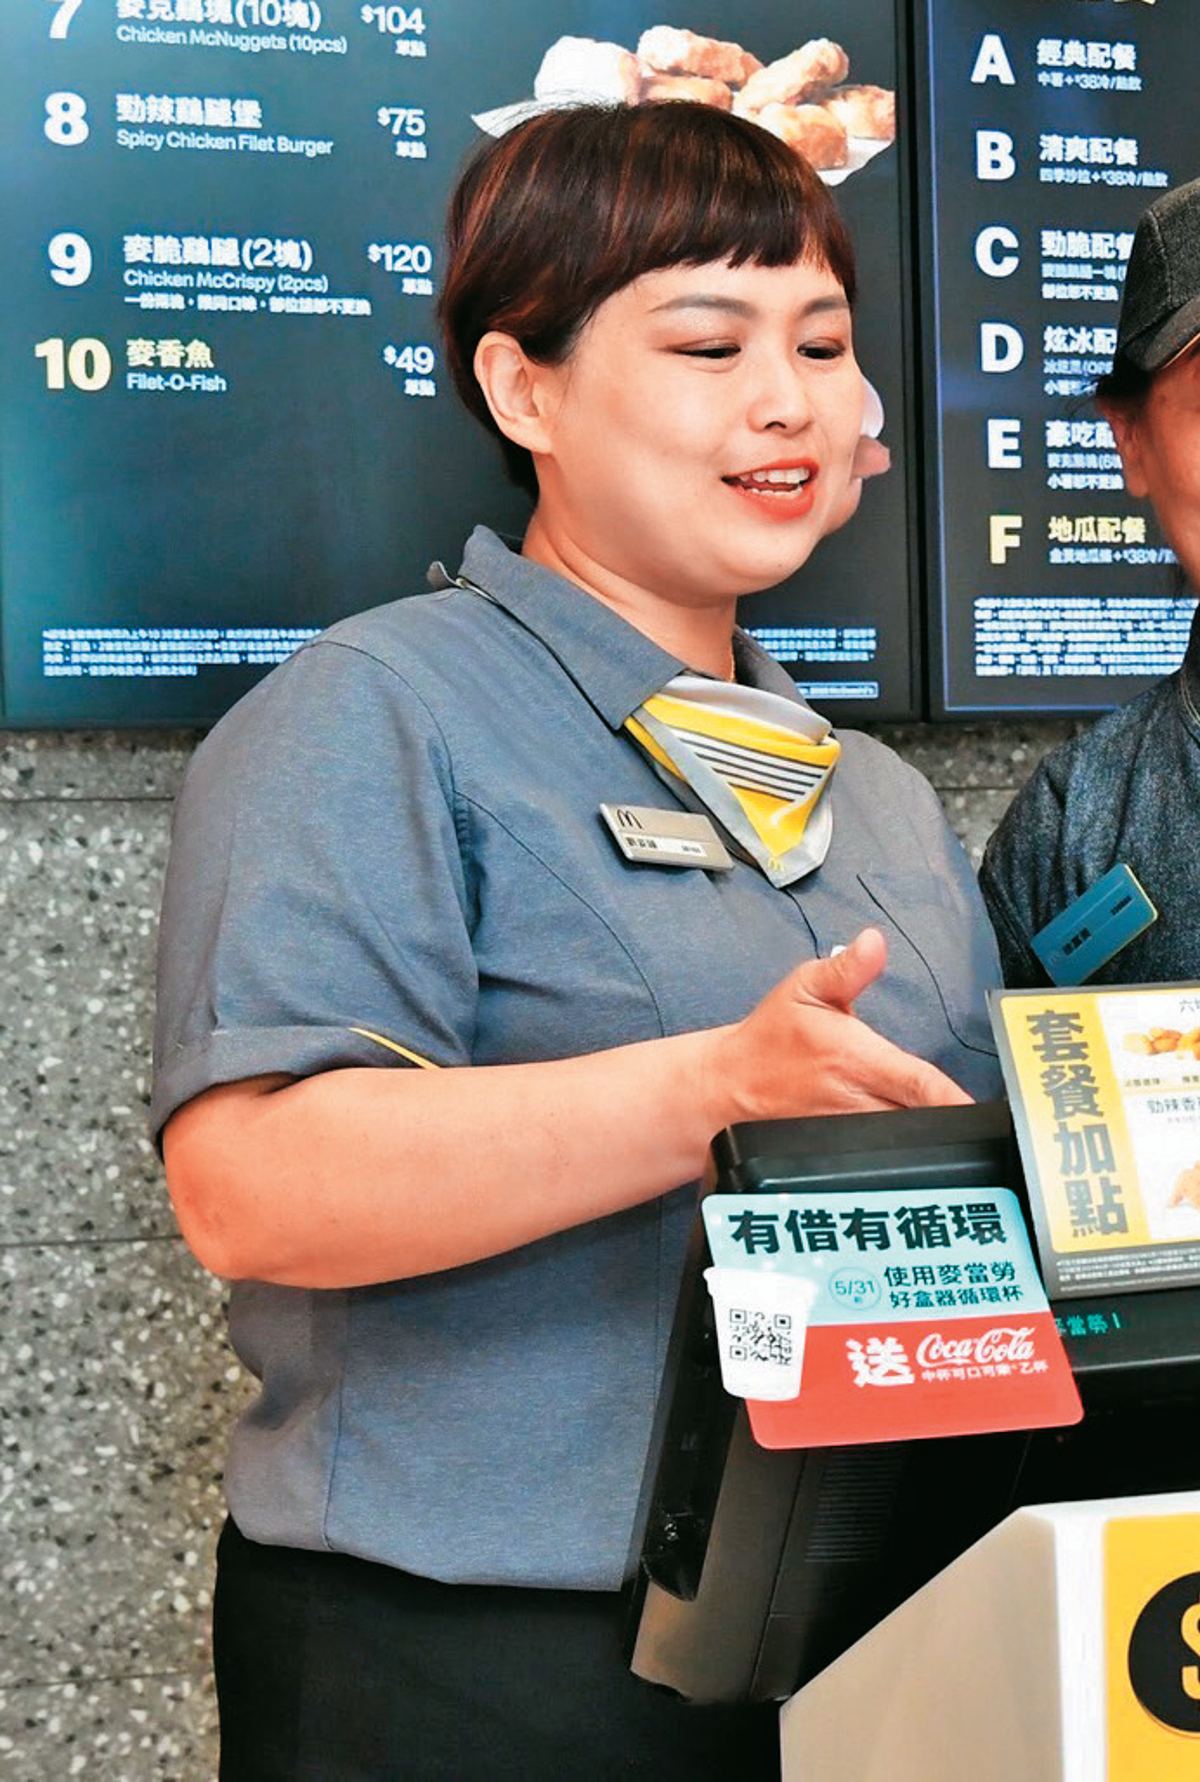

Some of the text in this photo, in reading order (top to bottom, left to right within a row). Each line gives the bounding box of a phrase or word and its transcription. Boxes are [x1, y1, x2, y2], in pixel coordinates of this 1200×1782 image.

[49, 0, 83, 39] 7
[361, 5, 426, 34] $104
[116, 26, 347, 54] Chicken McNuggets (10pcs)
[970, 34, 1016, 85] A
[44, 92, 89, 145] 8
[377, 107, 426, 135] $75
[116, 130, 334, 156] Spicy Chicken Filet Burger
[976, 130, 1016, 181] B
[48, 232, 93, 287] 9
[367, 244, 433, 273] $120
[975, 226, 1019, 278] C
[123, 269, 328, 294] Chicken McCrispy (2pcs)
[35, 338, 112, 391] 10
[126, 338, 214, 368] 麥香魚
[383, 345, 435, 374] $49
[980, 322, 1024, 374] D
[127, 373, 227, 392] Filet-O-Fish
[987, 418, 1022, 469] E
[989, 514, 1023, 565] F
[1048, 515, 1146, 544] 地瓜配餐
[1026, 1009, 1129, 1240] 套餐加點
[728, 1201, 1007, 1255] 有借有循環
[835, 1280, 875, 1296] 5/31
[884, 1261, 1016, 1287] 使用麥當勞
[889, 1284, 1024, 1310] 好盒器循環杯
[846, 1336, 915, 1388] 送
[916, 1327, 1036, 1368] Coca-Cola
